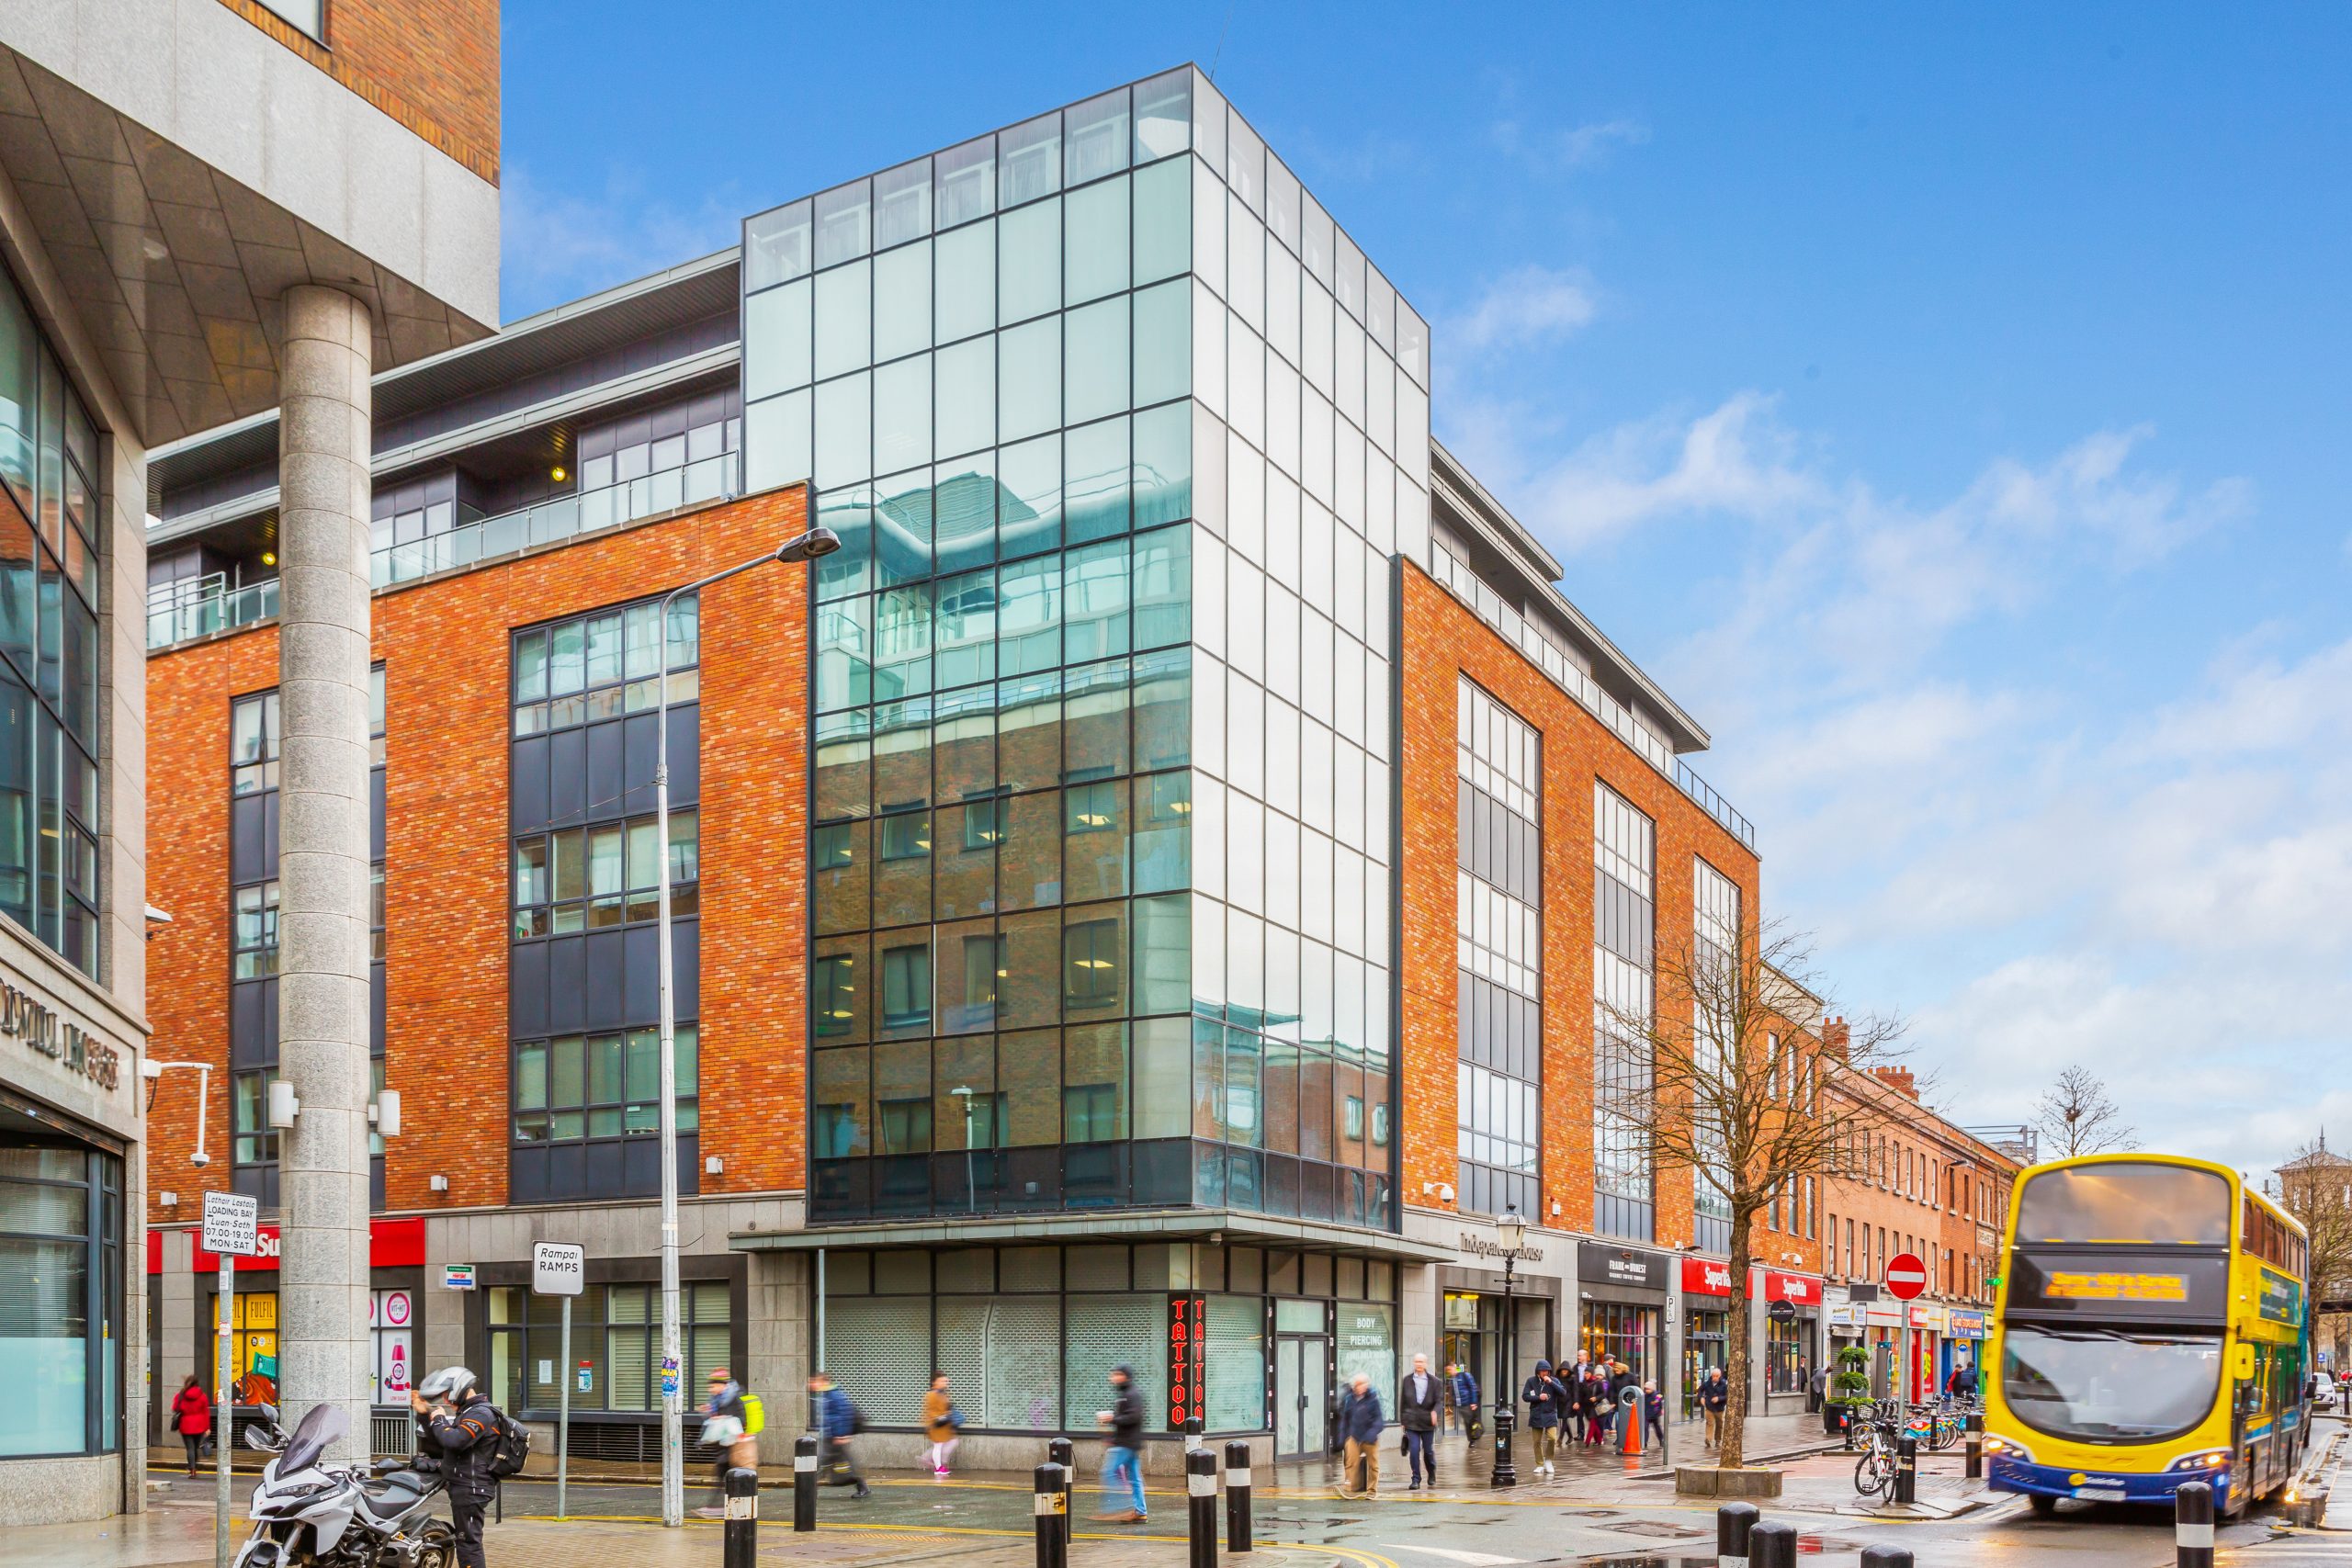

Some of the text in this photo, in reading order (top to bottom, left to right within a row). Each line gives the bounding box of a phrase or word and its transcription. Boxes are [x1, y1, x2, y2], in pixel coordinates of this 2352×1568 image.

[208, 1206, 254, 1218] LOADING BAY
[205, 1228, 254, 1240] 07.00-19.00
[209, 1238, 250, 1250] MON-SAT
[539, 1261, 578, 1272] RAMPS
[250, 1301, 273, 1318] FULFIL
[1356, 1317, 1375, 1328] BODY
[1350, 1335, 1383, 1346] PIERCING
[1171, 1300, 1188, 1426] TATTOO
[1194, 1300, 1204, 1421] TATTOO
[319, 1490, 340, 1501] DUCATI
